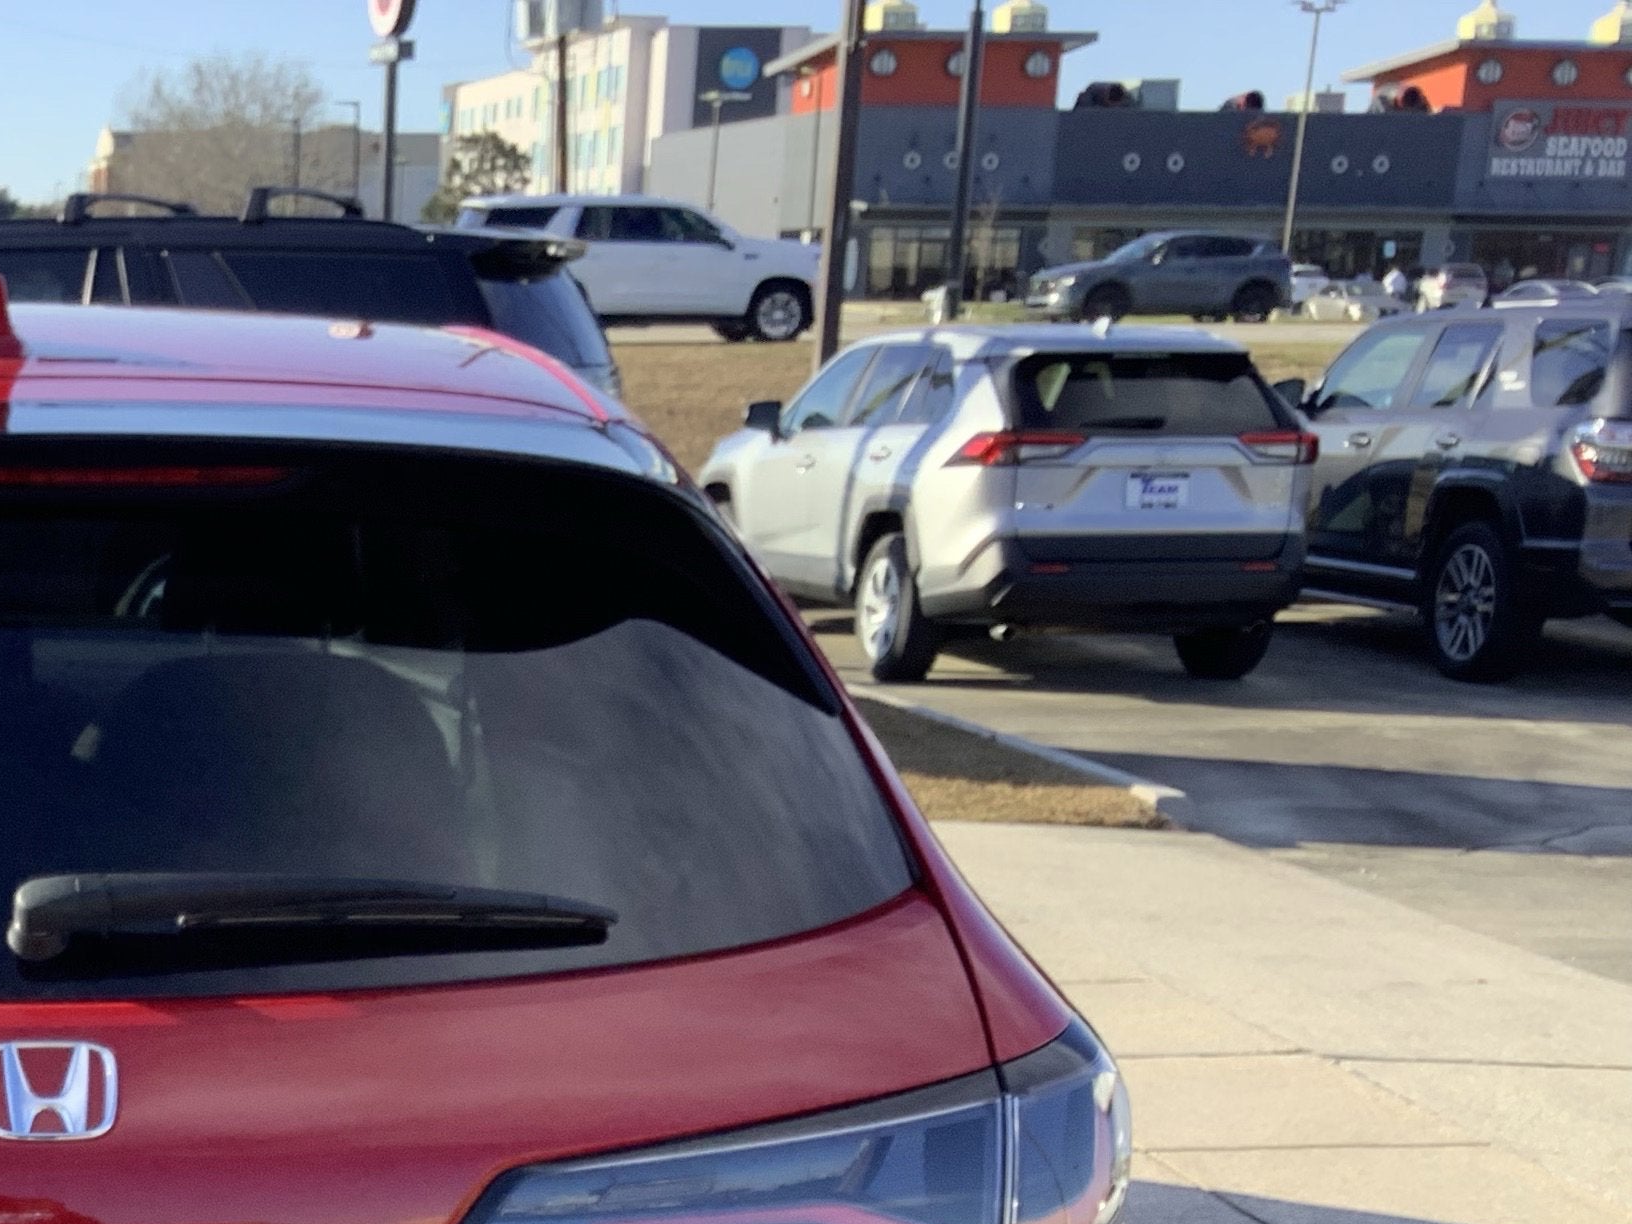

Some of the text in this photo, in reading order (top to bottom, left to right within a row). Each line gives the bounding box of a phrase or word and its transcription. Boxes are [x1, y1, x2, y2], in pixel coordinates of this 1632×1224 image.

[1546, 135, 1628, 158] SEAFOOD
[1490, 157, 1582, 176] RESTAURANT
[1597, 159, 1626, 177] BAR
